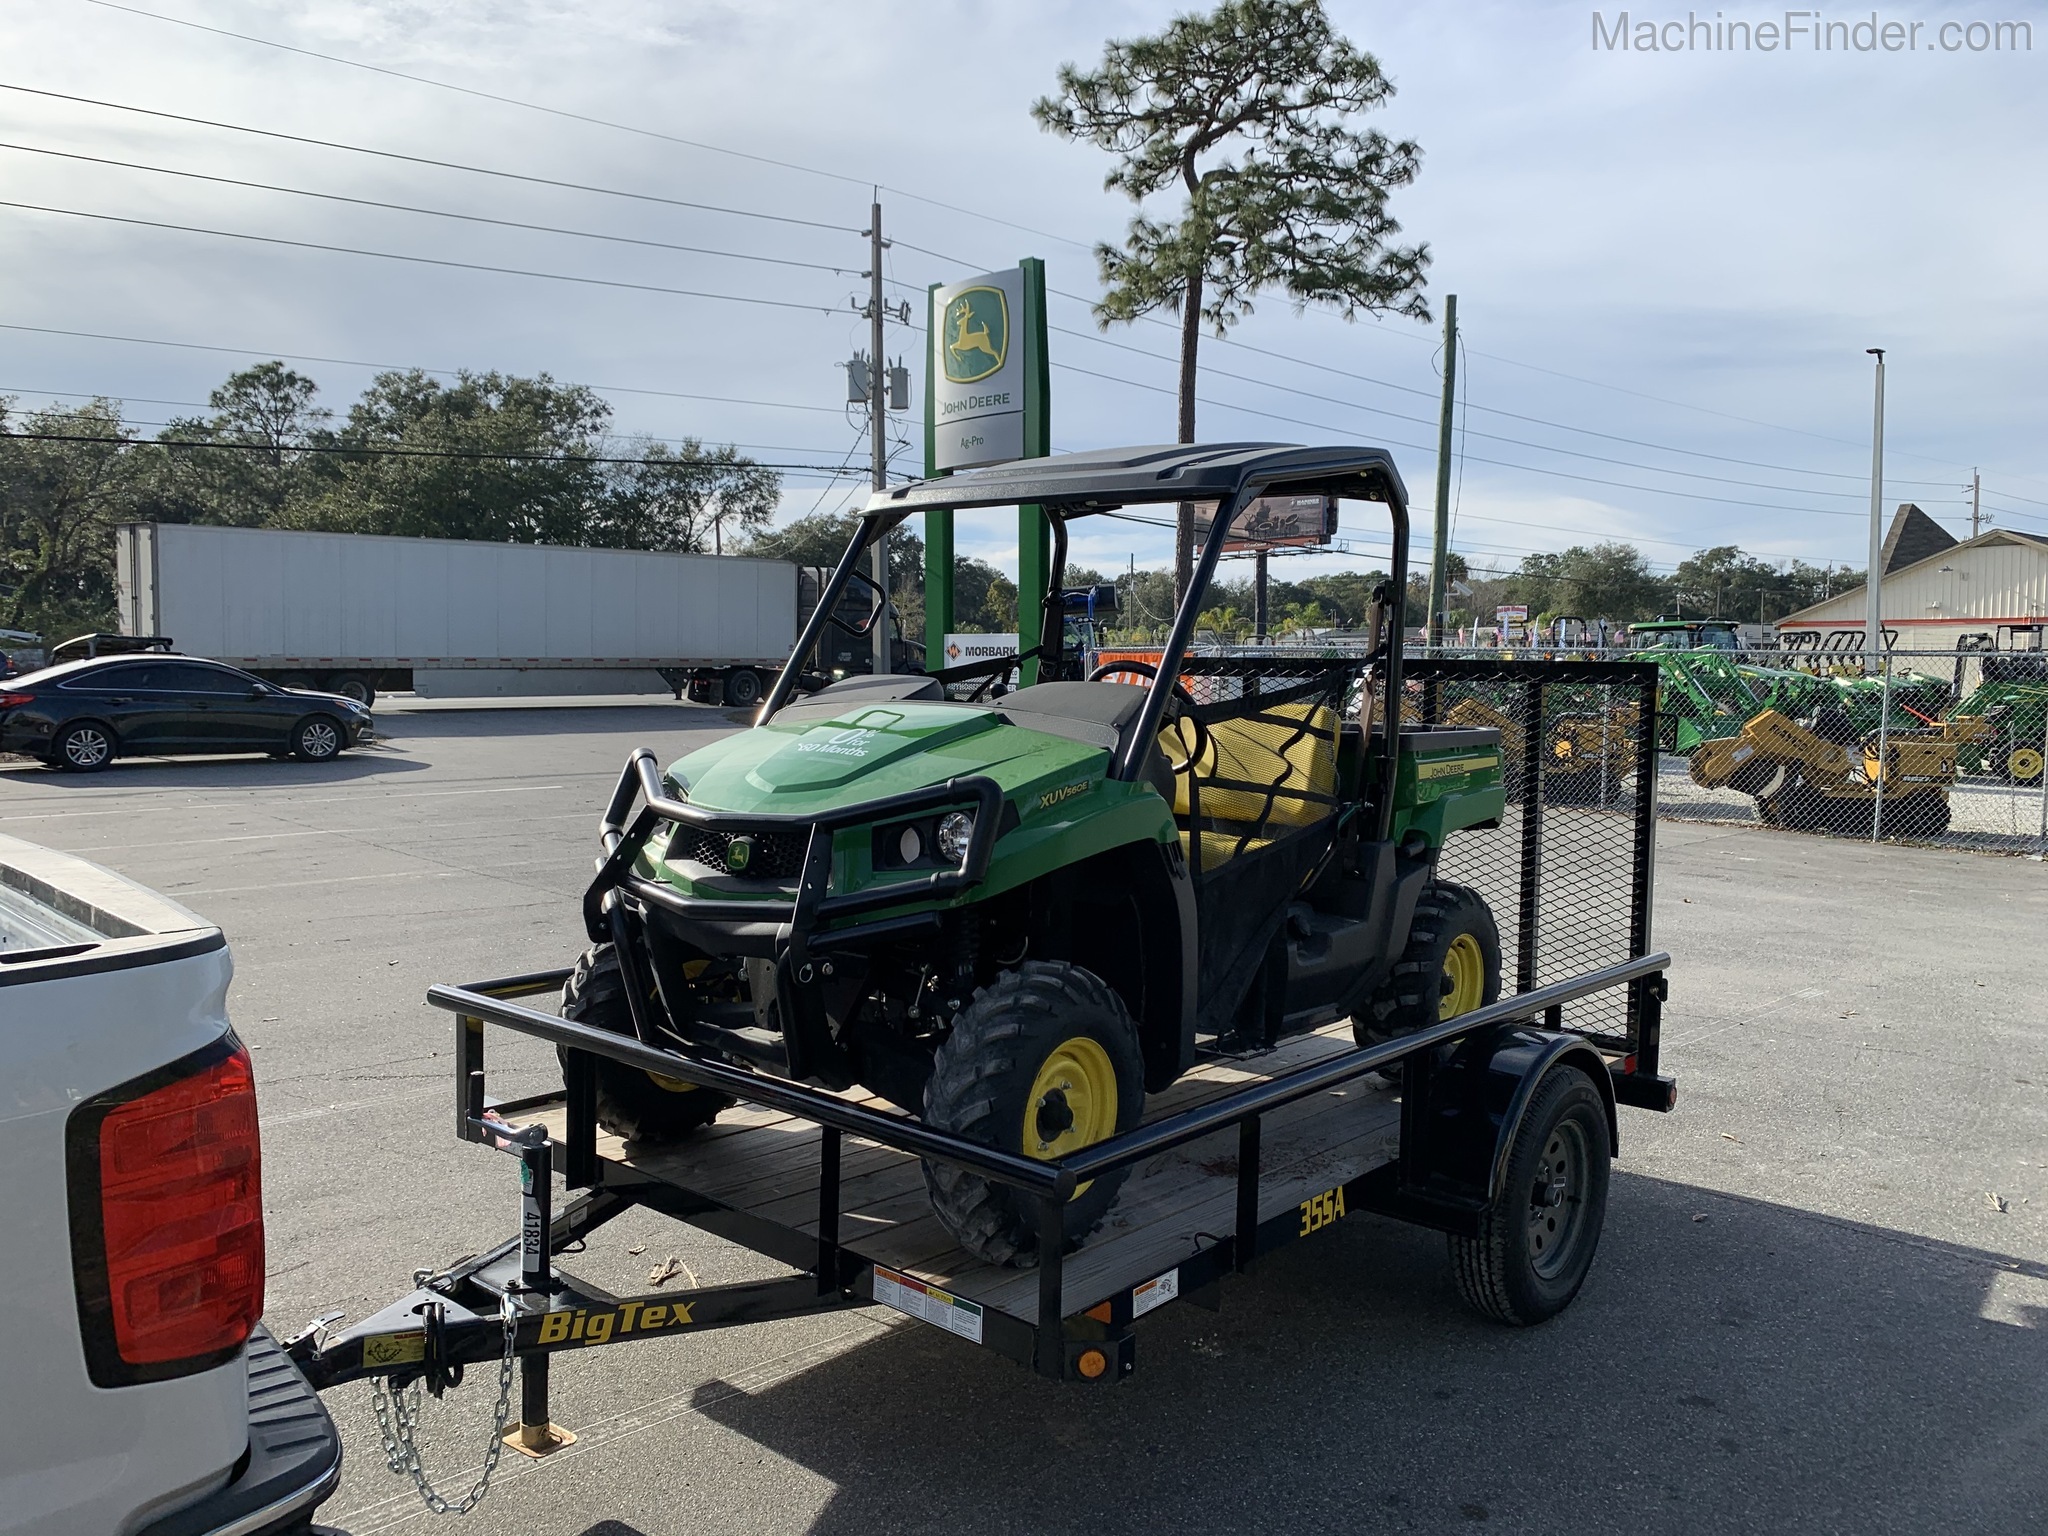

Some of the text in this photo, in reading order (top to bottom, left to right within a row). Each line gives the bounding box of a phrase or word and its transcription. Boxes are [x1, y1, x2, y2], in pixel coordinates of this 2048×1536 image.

[942, 392, 1011, 416] JOHN DEERE
[961, 435, 984, 449] Ag-Pro
[965, 646, 1017, 657] MORBARK
[815, 744, 869, 757] Months
[1430, 763, 1465, 778] JOHN DEERE
[1040, 780, 1088, 810] XUV560E
[524, 1211, 541, 1256] 41834
